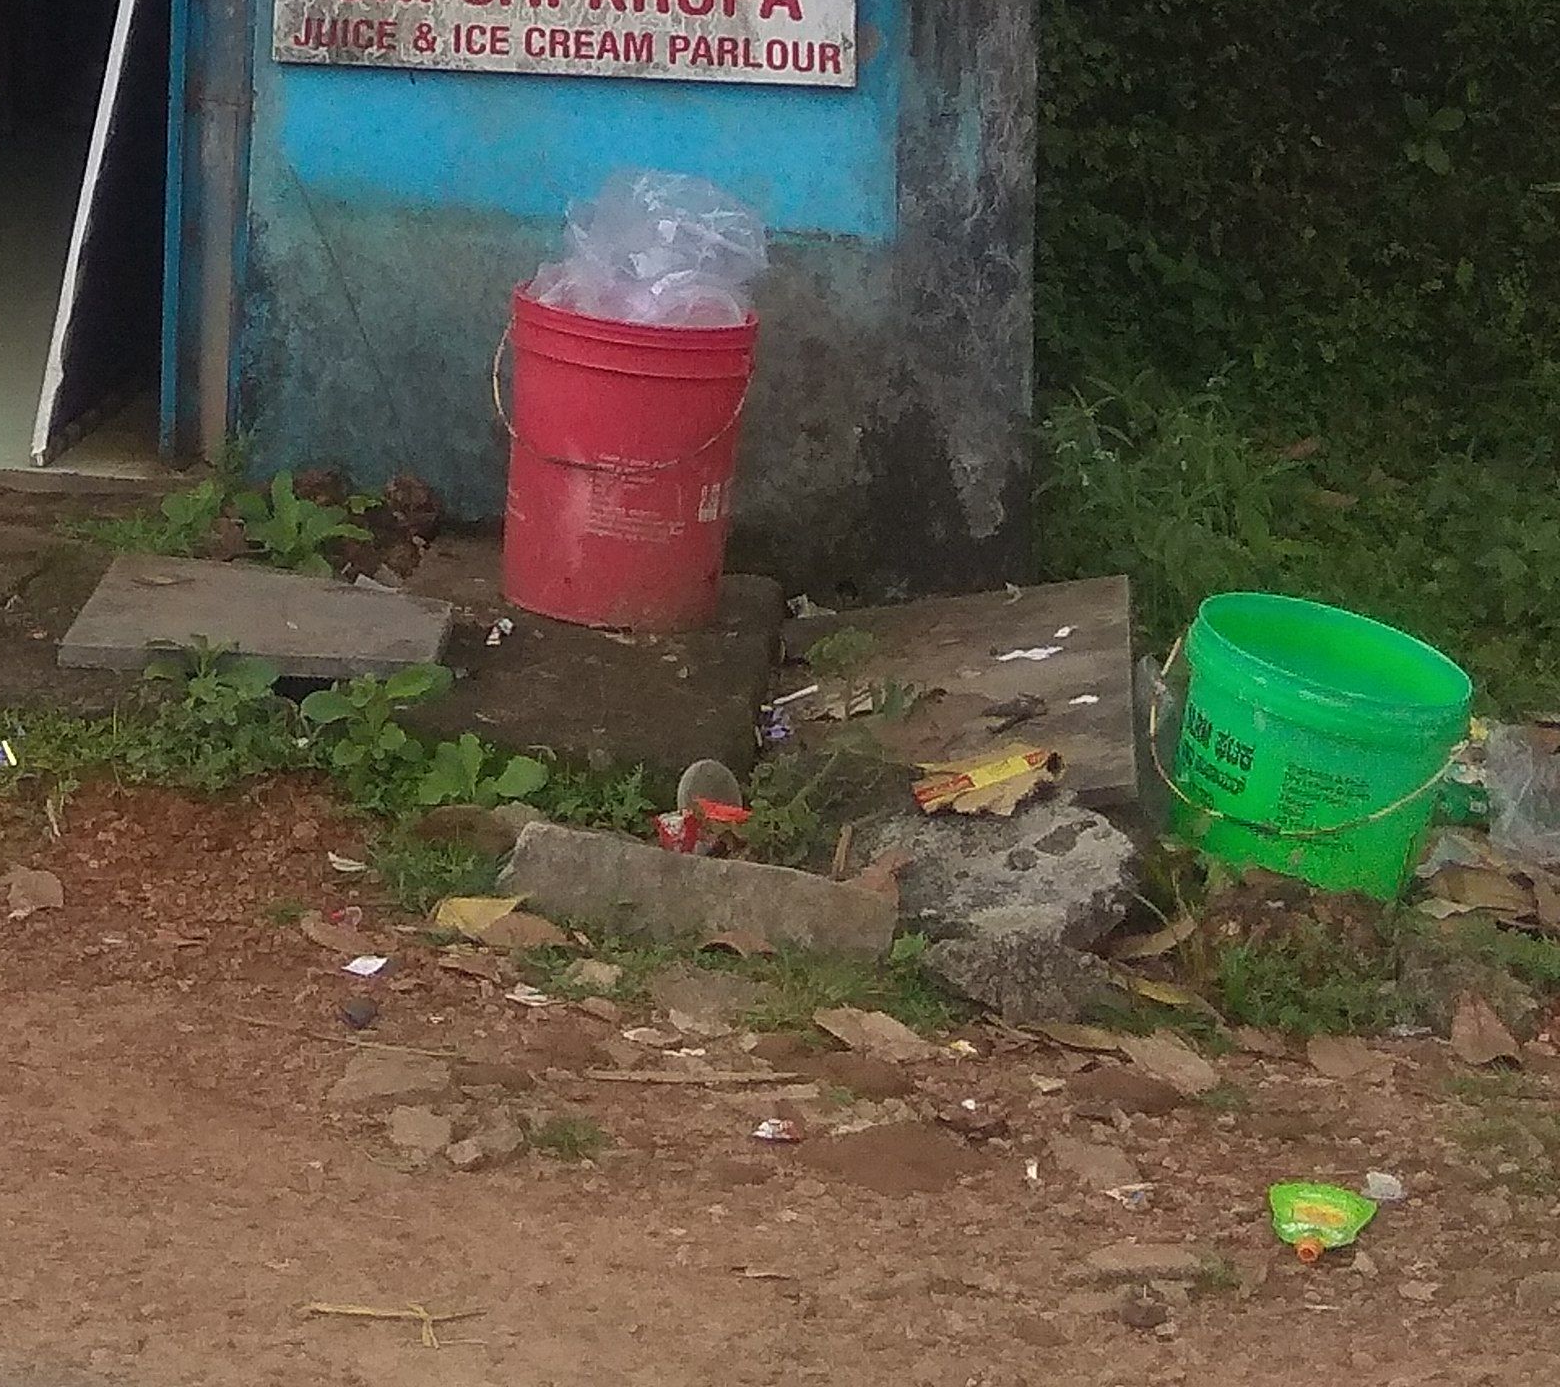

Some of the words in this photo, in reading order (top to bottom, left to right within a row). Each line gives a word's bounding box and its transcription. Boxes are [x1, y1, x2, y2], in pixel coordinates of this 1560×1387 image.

[293, 17, 396, 52] JUICE
[413, 22, 437, 53] &
[453, 24, 512, 57] ICE
[523, 27, 653, 64] CREAM
[668, 34, 842, 74] PARLOUR
